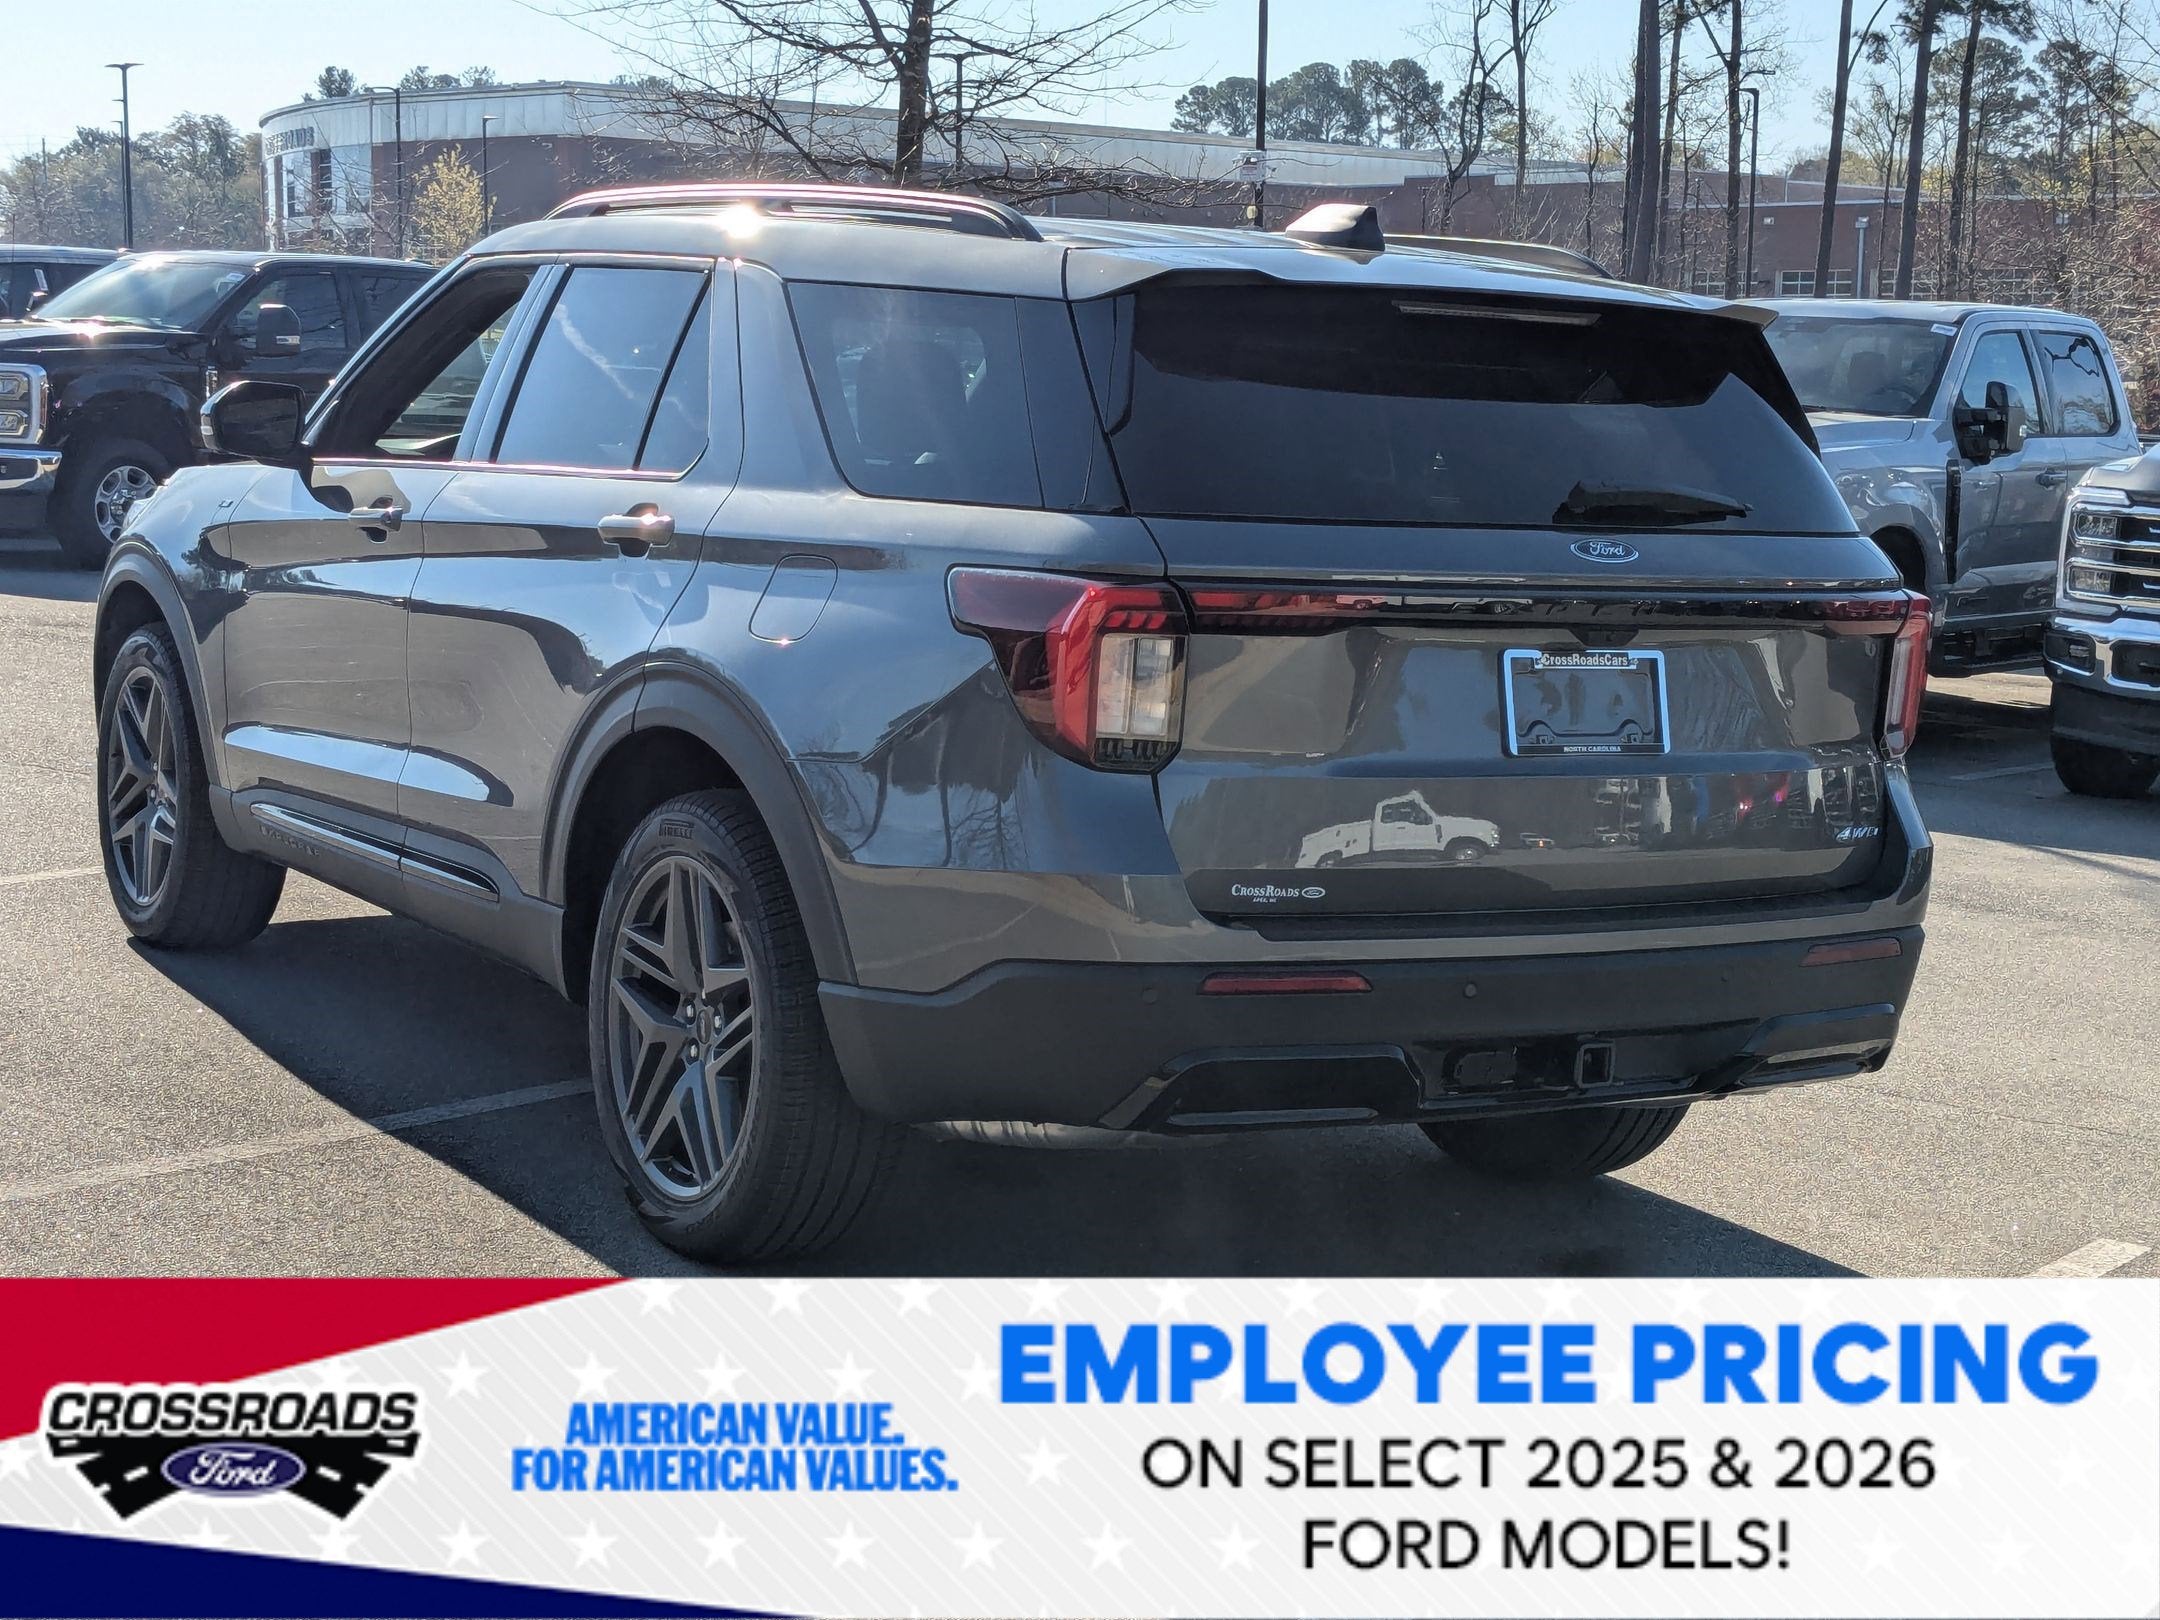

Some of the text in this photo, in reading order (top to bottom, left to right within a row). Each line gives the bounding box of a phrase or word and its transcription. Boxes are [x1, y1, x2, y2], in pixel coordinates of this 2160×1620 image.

[1589, 540, 1626, 557] Ford
[1541, 653, 1629, 667] CrossRoadsCars
[1588, 745, 1622, 753] CAROLINA
[1836, 826, 1879, 840] 4WD
